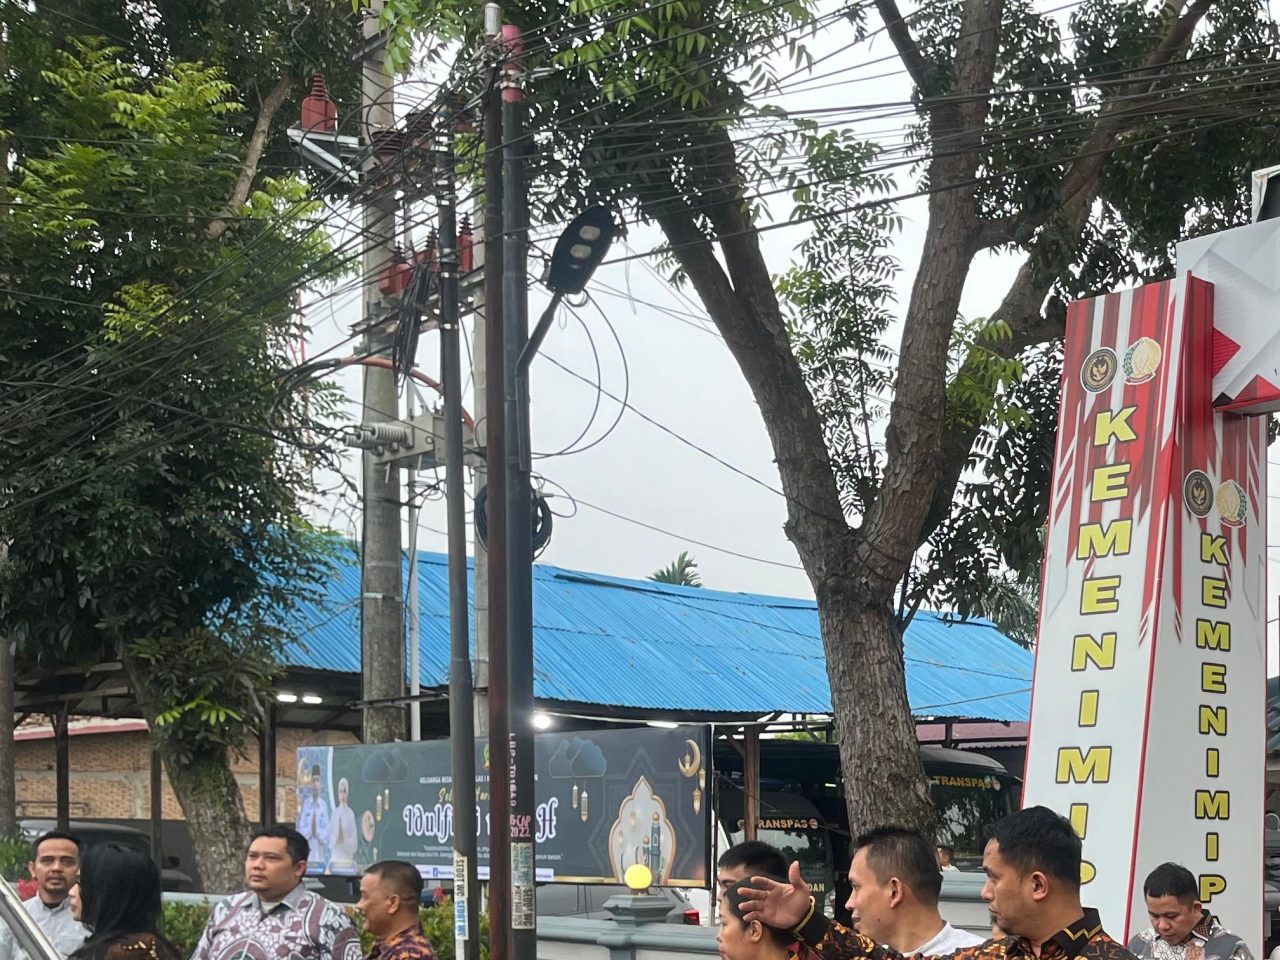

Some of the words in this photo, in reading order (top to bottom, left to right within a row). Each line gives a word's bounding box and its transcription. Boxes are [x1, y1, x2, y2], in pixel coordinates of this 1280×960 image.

[1195, 530, 1232, 926] KEMENIMIP
[933, 775, 992, 789] TRANSPAS
[757, 818, 808, 829] RANSPAS
[456, 859, 465, 883] SEDOT
[456, 884, 465, 897] WC
[807, 883, 824, 892] DAN
